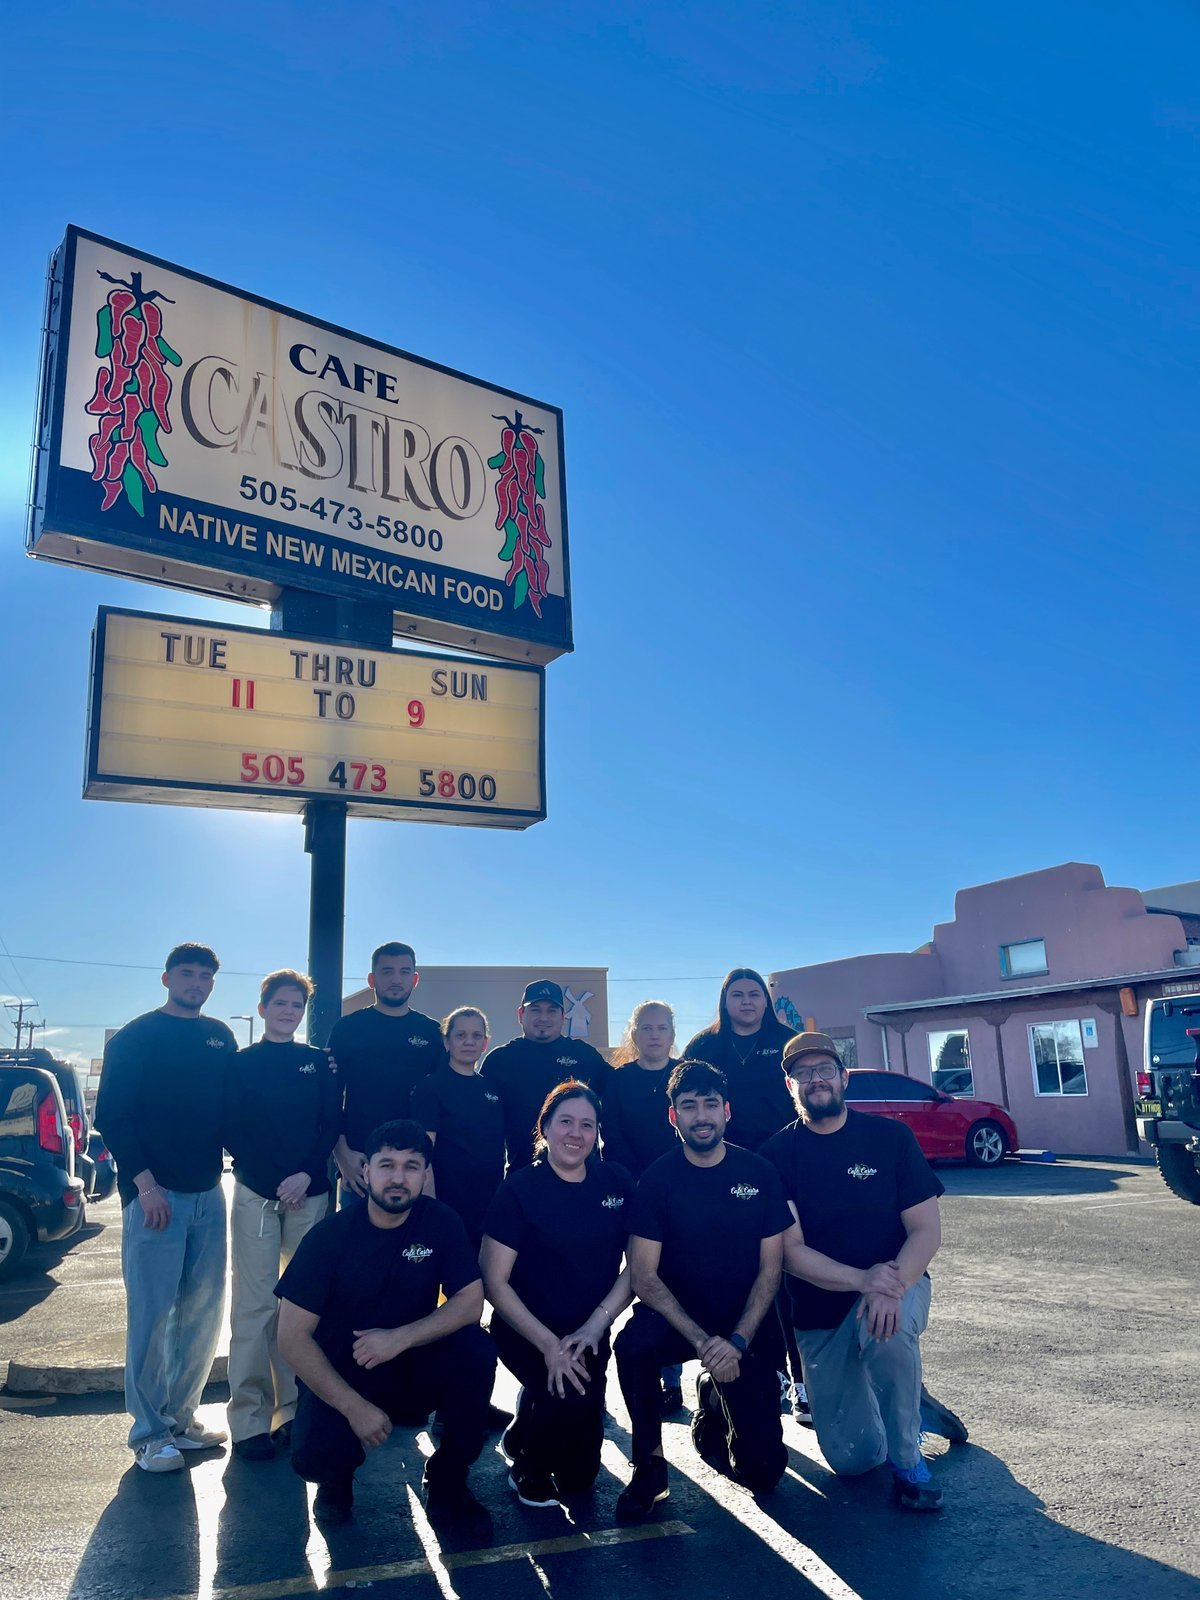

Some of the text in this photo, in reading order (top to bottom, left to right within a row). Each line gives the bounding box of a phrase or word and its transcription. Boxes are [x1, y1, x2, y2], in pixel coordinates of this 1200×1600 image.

[289, 344, 399, 404] CAFE
[181, 355, 487, 521] CASTRO
[239, 474, 444, 553] 505-473-5800
[158, 503, 504, 612] NATIVE NEW MEXICAN FOOD
[160, 632, 488, 701] TUE THRU SUN
[313, 688, 355, 720] TO
[407, 699, 425, 728] 9
[240, 752, 497, 801] 505 473 5800
